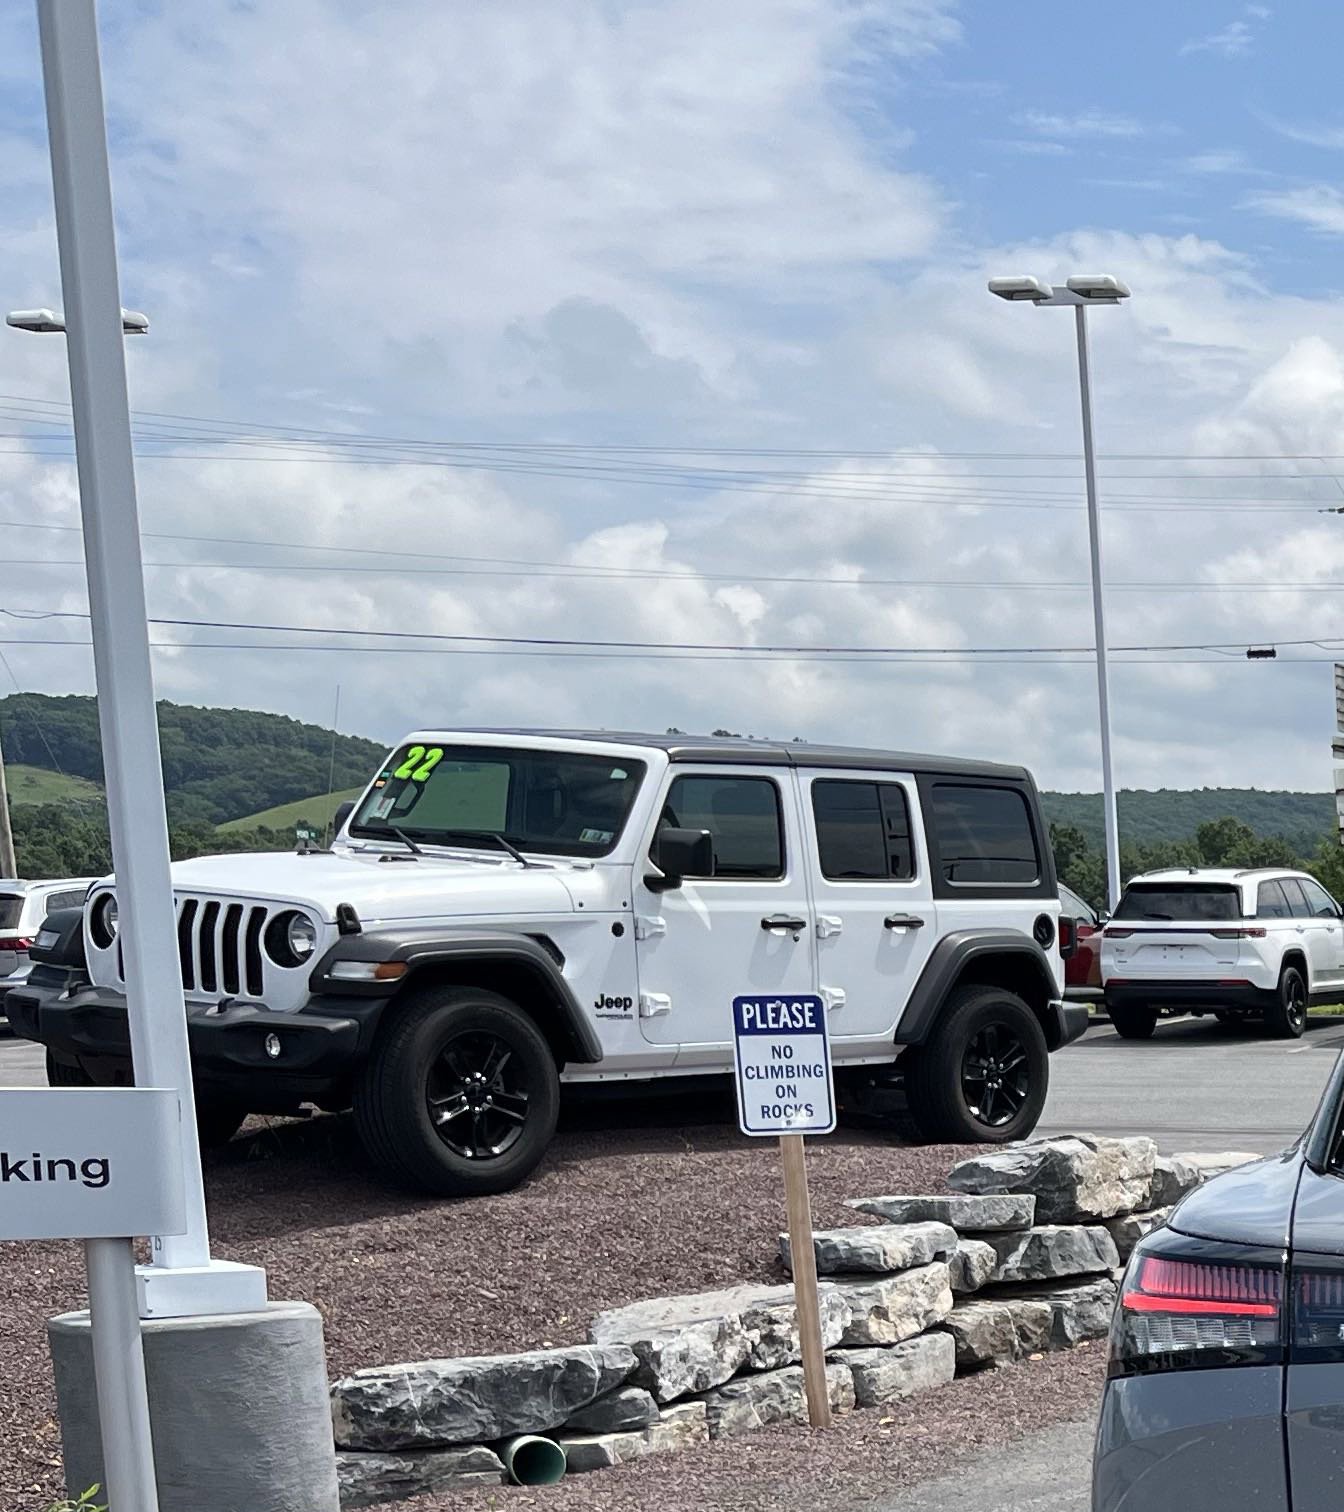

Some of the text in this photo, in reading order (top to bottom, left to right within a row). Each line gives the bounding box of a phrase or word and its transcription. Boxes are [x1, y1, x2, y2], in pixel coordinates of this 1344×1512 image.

[394, 746, 444, 782] 22
[594, 993, 633, 1012] Jeep
[741, 1002, 816, 1029] PLEASE
[771, 1045, 793, 1059] NO
[744, 1064, 824, 1080] CLIMBING
[775, 1084, 797, 1098] ON
[761, 1103, 814, 1119] ROCKS
[0, 1152, 111, 1188] king
